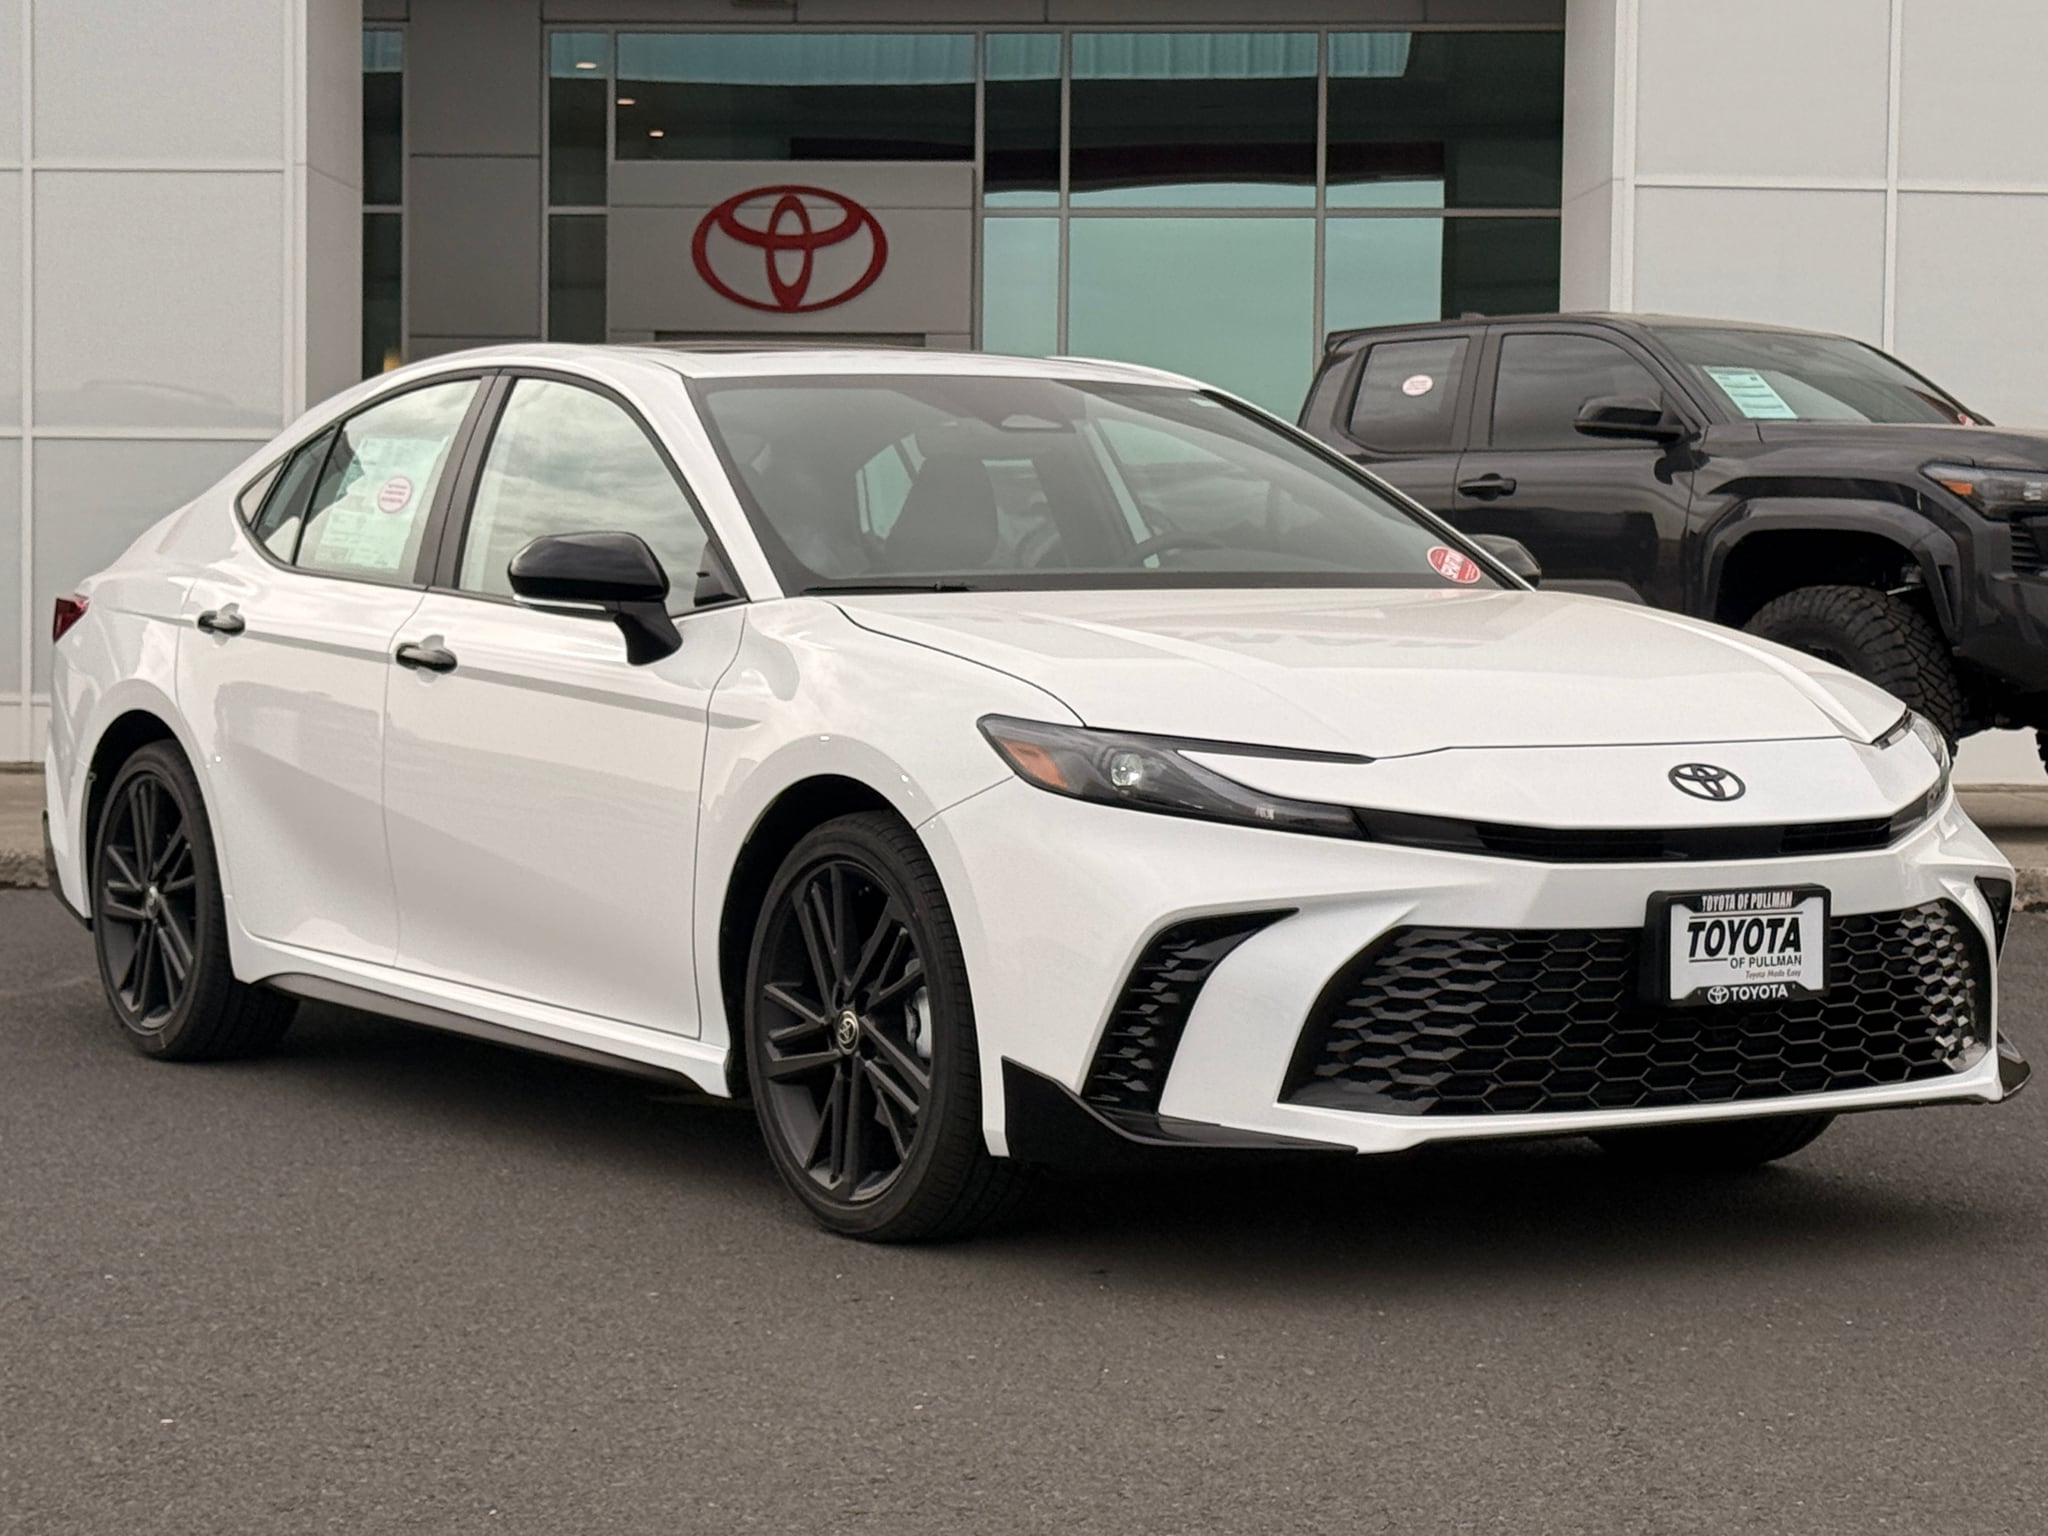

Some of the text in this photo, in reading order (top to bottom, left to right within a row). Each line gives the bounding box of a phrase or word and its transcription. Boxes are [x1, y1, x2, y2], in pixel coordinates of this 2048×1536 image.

[1702, 891, 1793, 912] TOYOTA OF PULLMAN
[1687, 917, 1802, 958] TOYOTA
[1730, 955, 1802, 969] OF PULLMAN
[1745, 970, 1765, 980] Toyota
[1730, 984, 1789, 1001] TOYOTA
